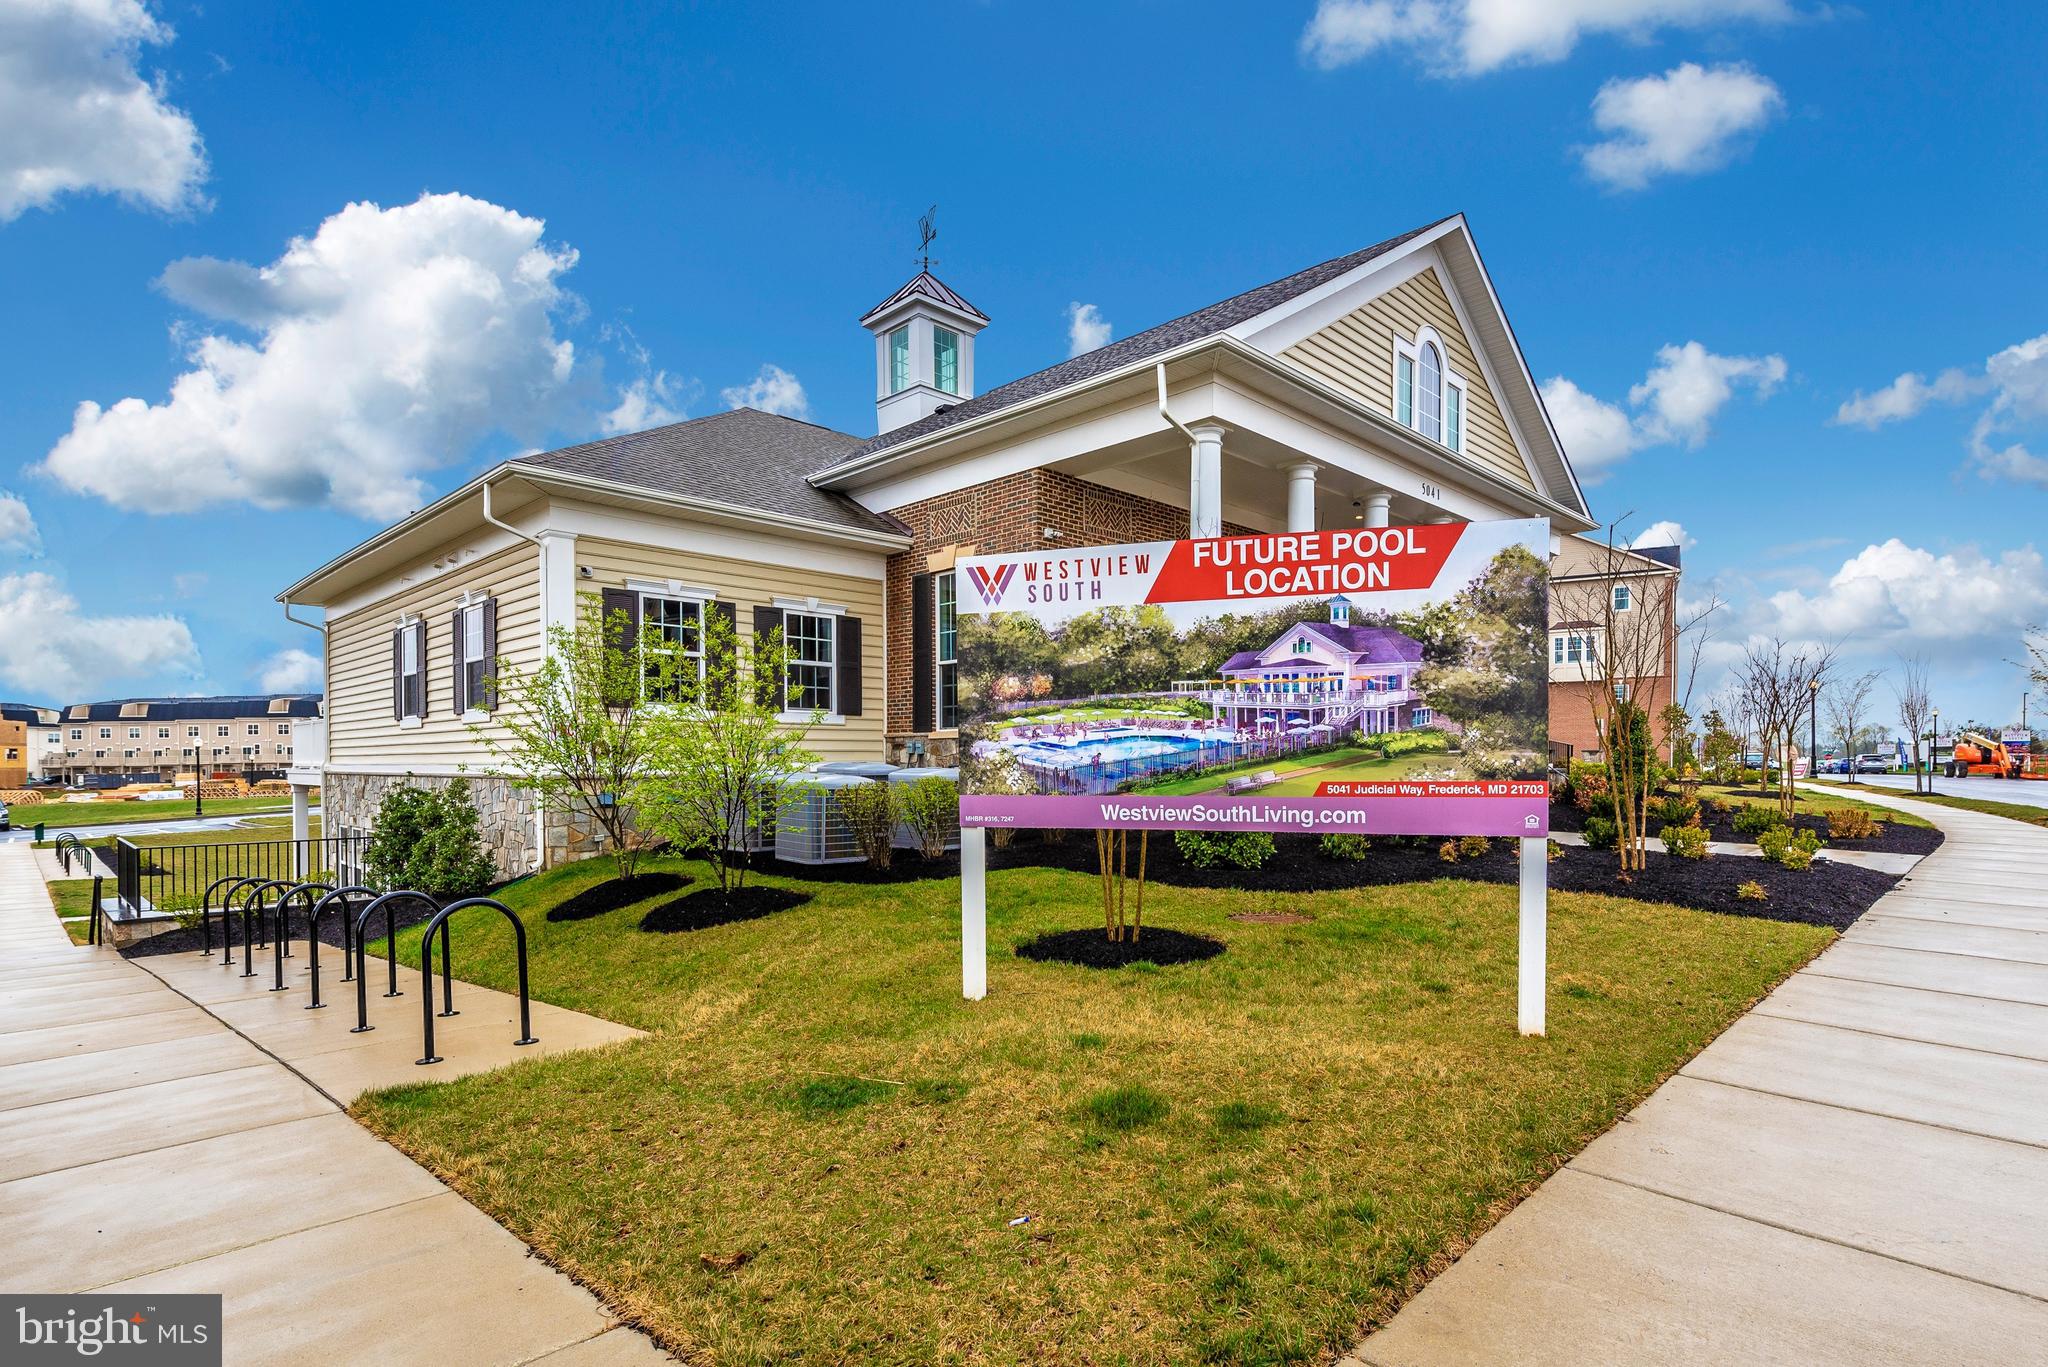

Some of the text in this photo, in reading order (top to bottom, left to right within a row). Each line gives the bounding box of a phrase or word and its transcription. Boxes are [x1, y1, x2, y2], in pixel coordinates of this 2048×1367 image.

[1422, 482, 1440, 500] 5041
[1193, 528, 1427, 568] FUTURE POOL
[1023, 554, 1150, 581] WESTVIEW
[1226, 561, 1390, 596] LOCATION
[1028, 581, 1101, 603] SOUTH
[1327, 784, 1544, 796] 5041 Judicial Way, Frederick, MD 21703
[1101, 804, 1366, 827] WestviewSouthLiving.com
